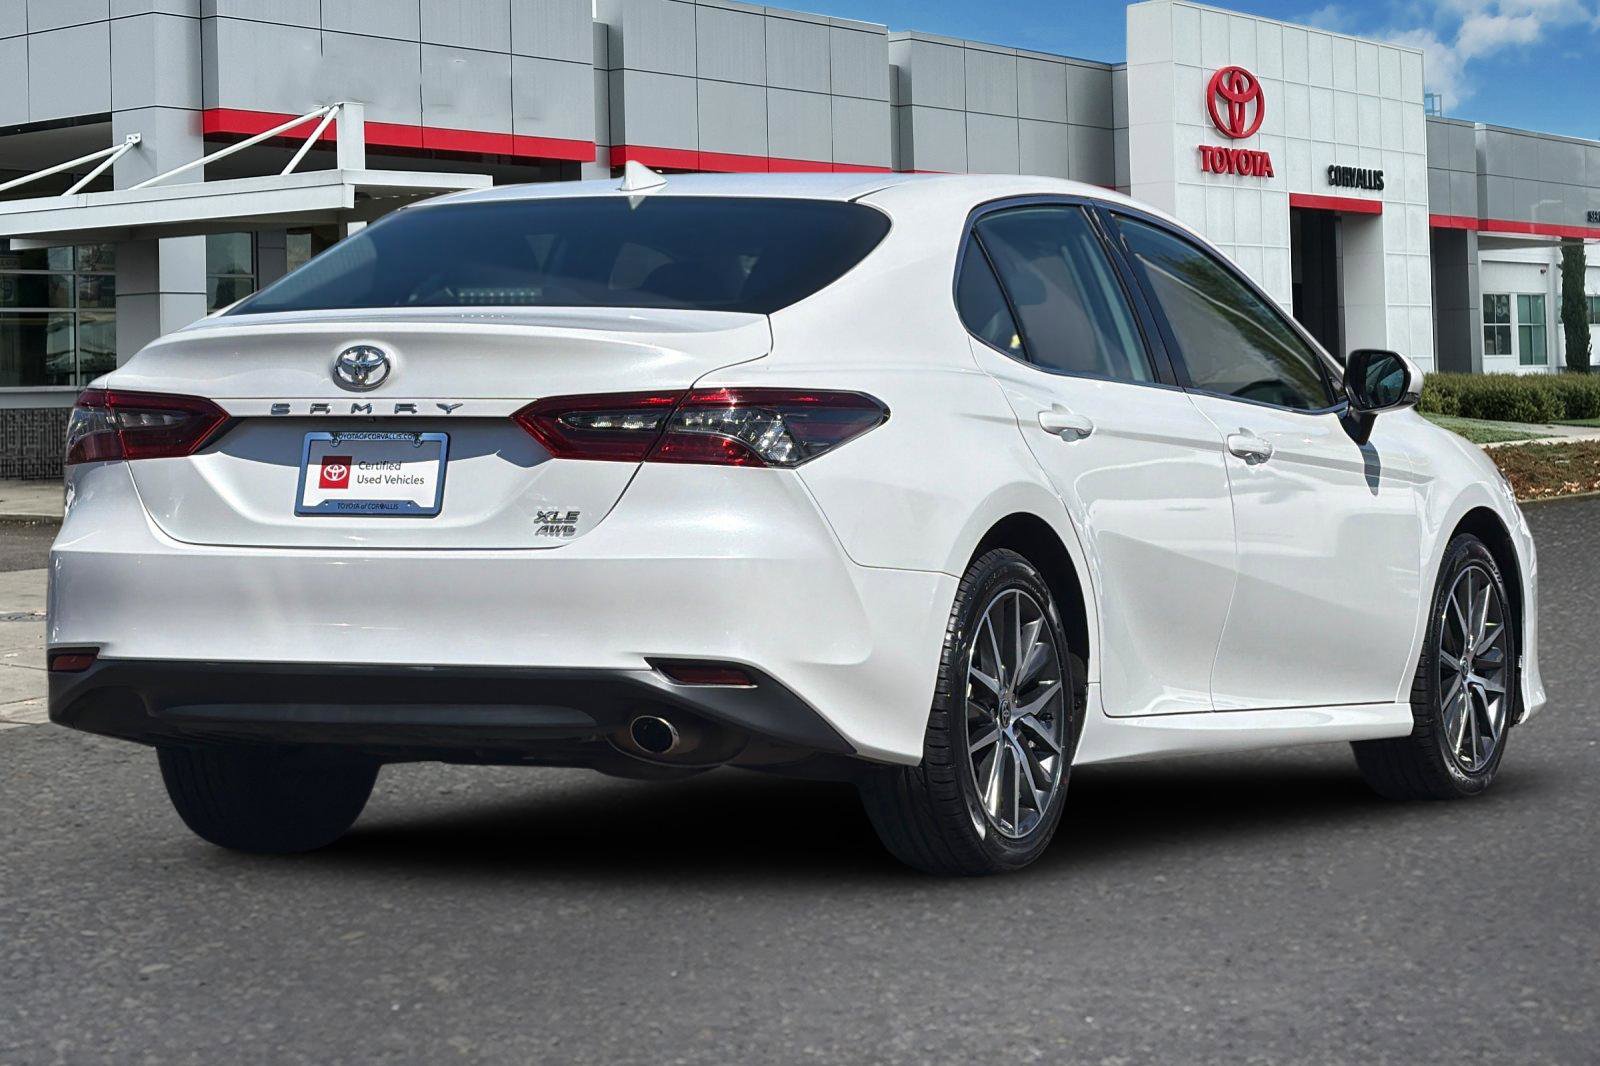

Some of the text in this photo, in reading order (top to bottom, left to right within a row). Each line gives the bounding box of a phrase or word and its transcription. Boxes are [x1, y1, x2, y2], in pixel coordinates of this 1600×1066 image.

[1199, 145, 1274, 178] TOYOTA
[1328, 164, 1385, 191] CORVALLIS
[333, 432, 418, 440] OYOTAOFCORVALLIS.CO
[358, 460, 402, 471] Certified
[357, 474, 425, 485] Used Vehicles
[337, 502, 400, 510] TOYOTA of CORVALLIS
[533, 510, 581, 524] XLE
[534, 525, 576, 537] AWD
